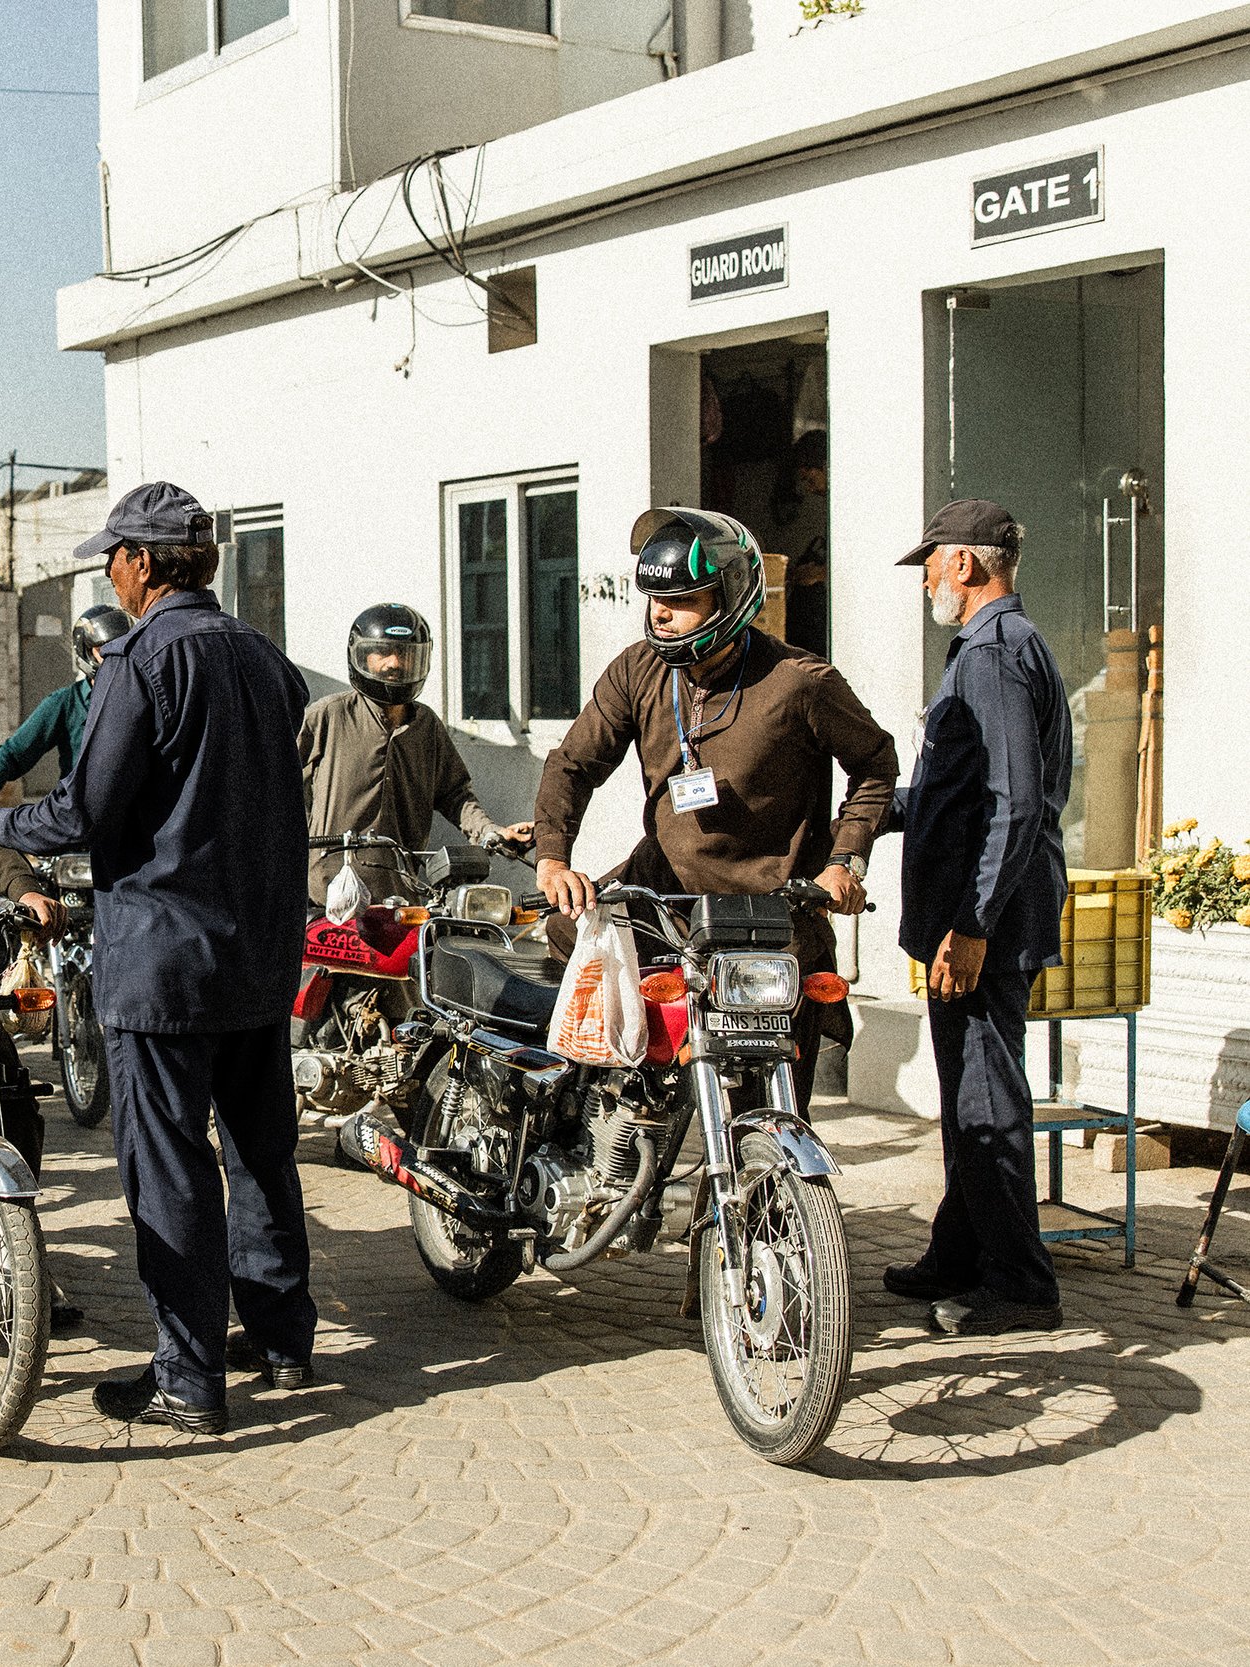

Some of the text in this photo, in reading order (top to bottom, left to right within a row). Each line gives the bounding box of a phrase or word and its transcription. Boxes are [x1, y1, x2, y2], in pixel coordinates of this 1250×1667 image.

[974, 167, 1097, 224] GATE 1
[691, 241, 784, 287] GUARD ROOM
[638, 562, 672, 579] DHOOM
[309, 946, 365, 960] WITH ME
[722, 1014, 789, 1031] ANS 1500
[726, 1039, 779, 1048] HONDA
